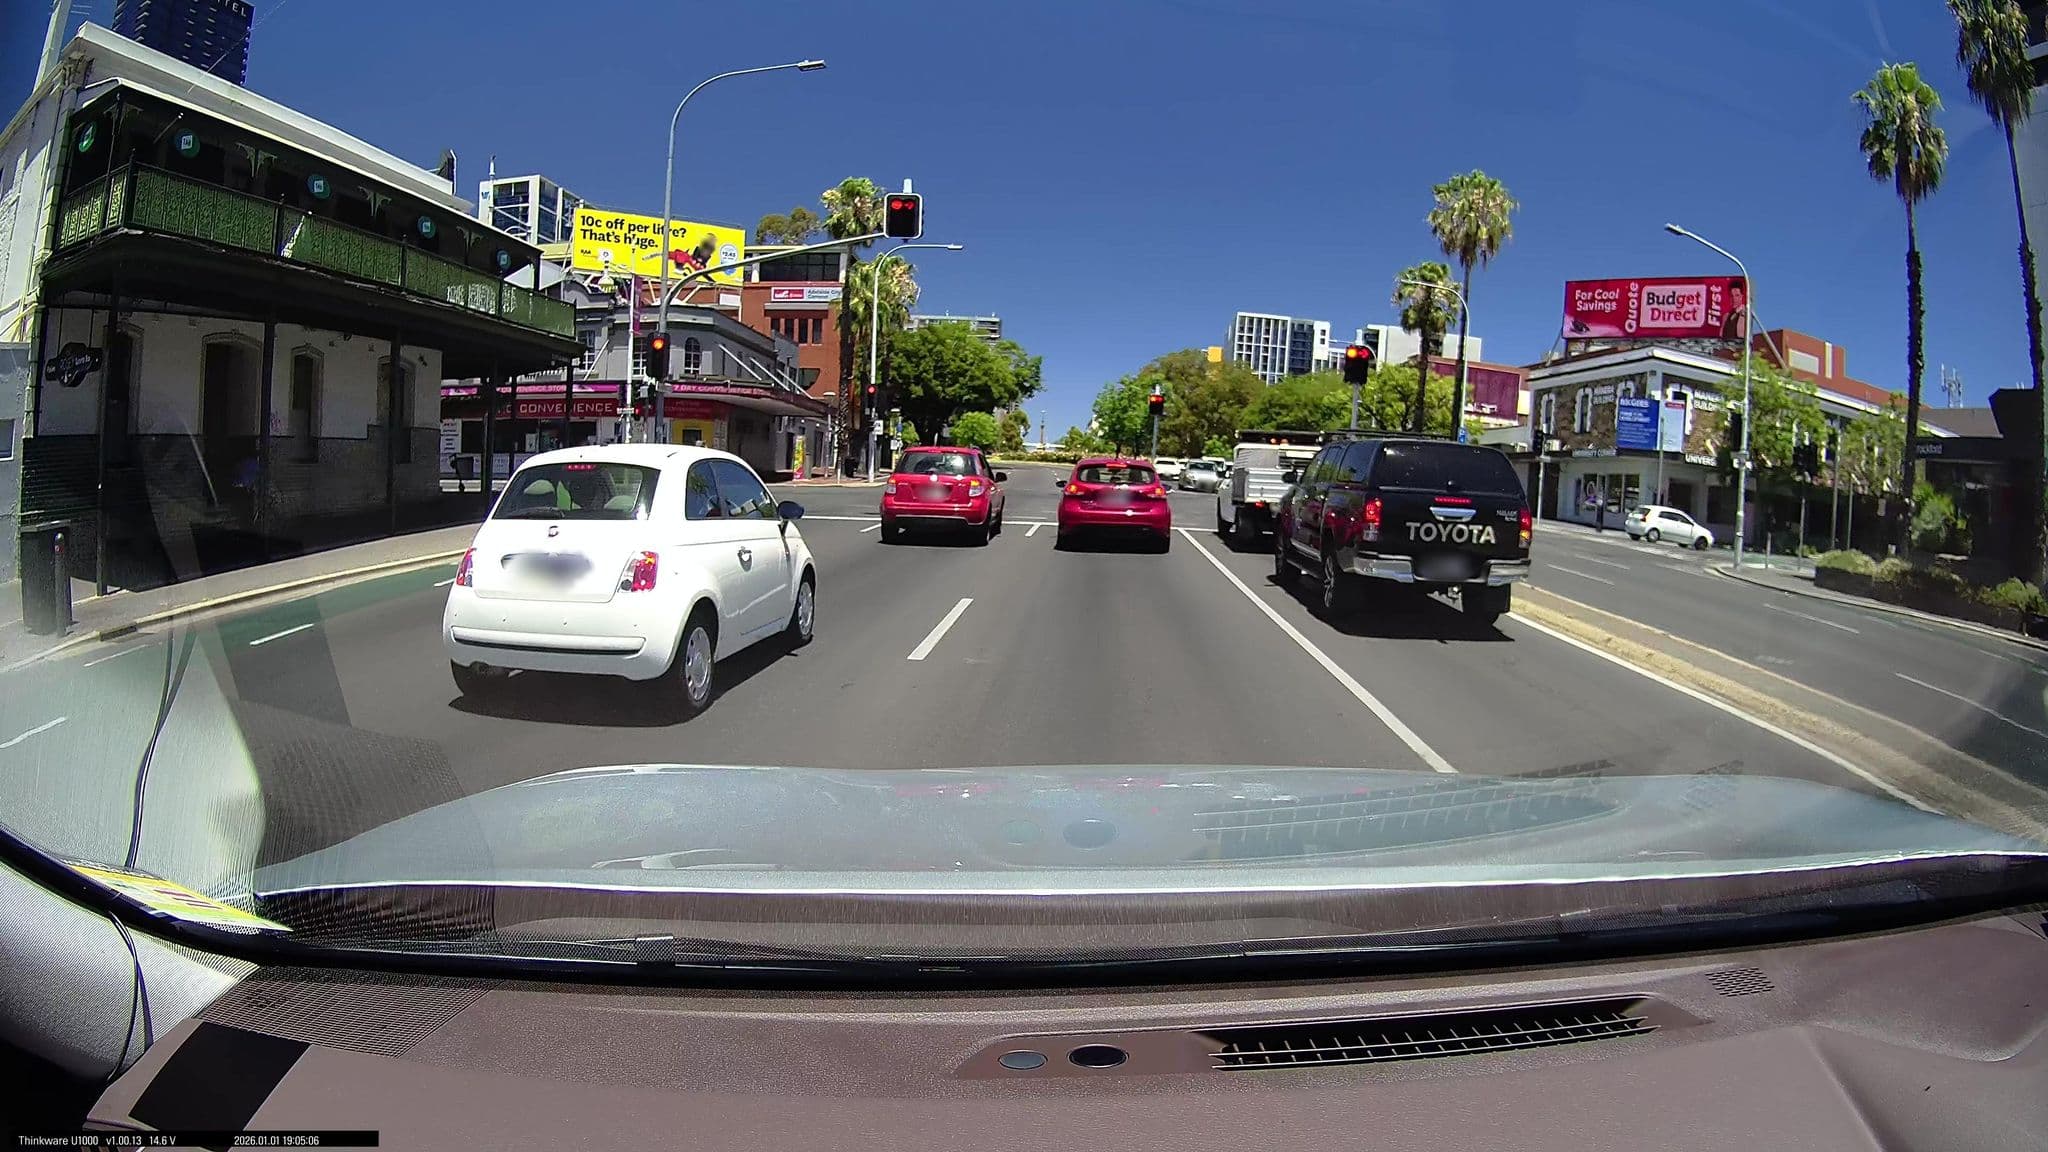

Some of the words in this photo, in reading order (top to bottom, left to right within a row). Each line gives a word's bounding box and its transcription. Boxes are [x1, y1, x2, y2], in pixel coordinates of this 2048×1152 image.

[581, 215, 602, 228] 10c
[606, 218, 625, 230] off
[628, 223, 650, 235] per
[1575, 289, 1593, 301] For
[1594, 287, 1620, 300] Cool
[1646, 291, 1701, 309] Budget
[1576, 299, 1617, 314] Savings
[1624, 282, 1639, 334] Quote
[1650, 308, 1698, 322] Direct
[1708, 284, 1722, 327] First
[1406, 522, 1496, 544] TOYOTA
